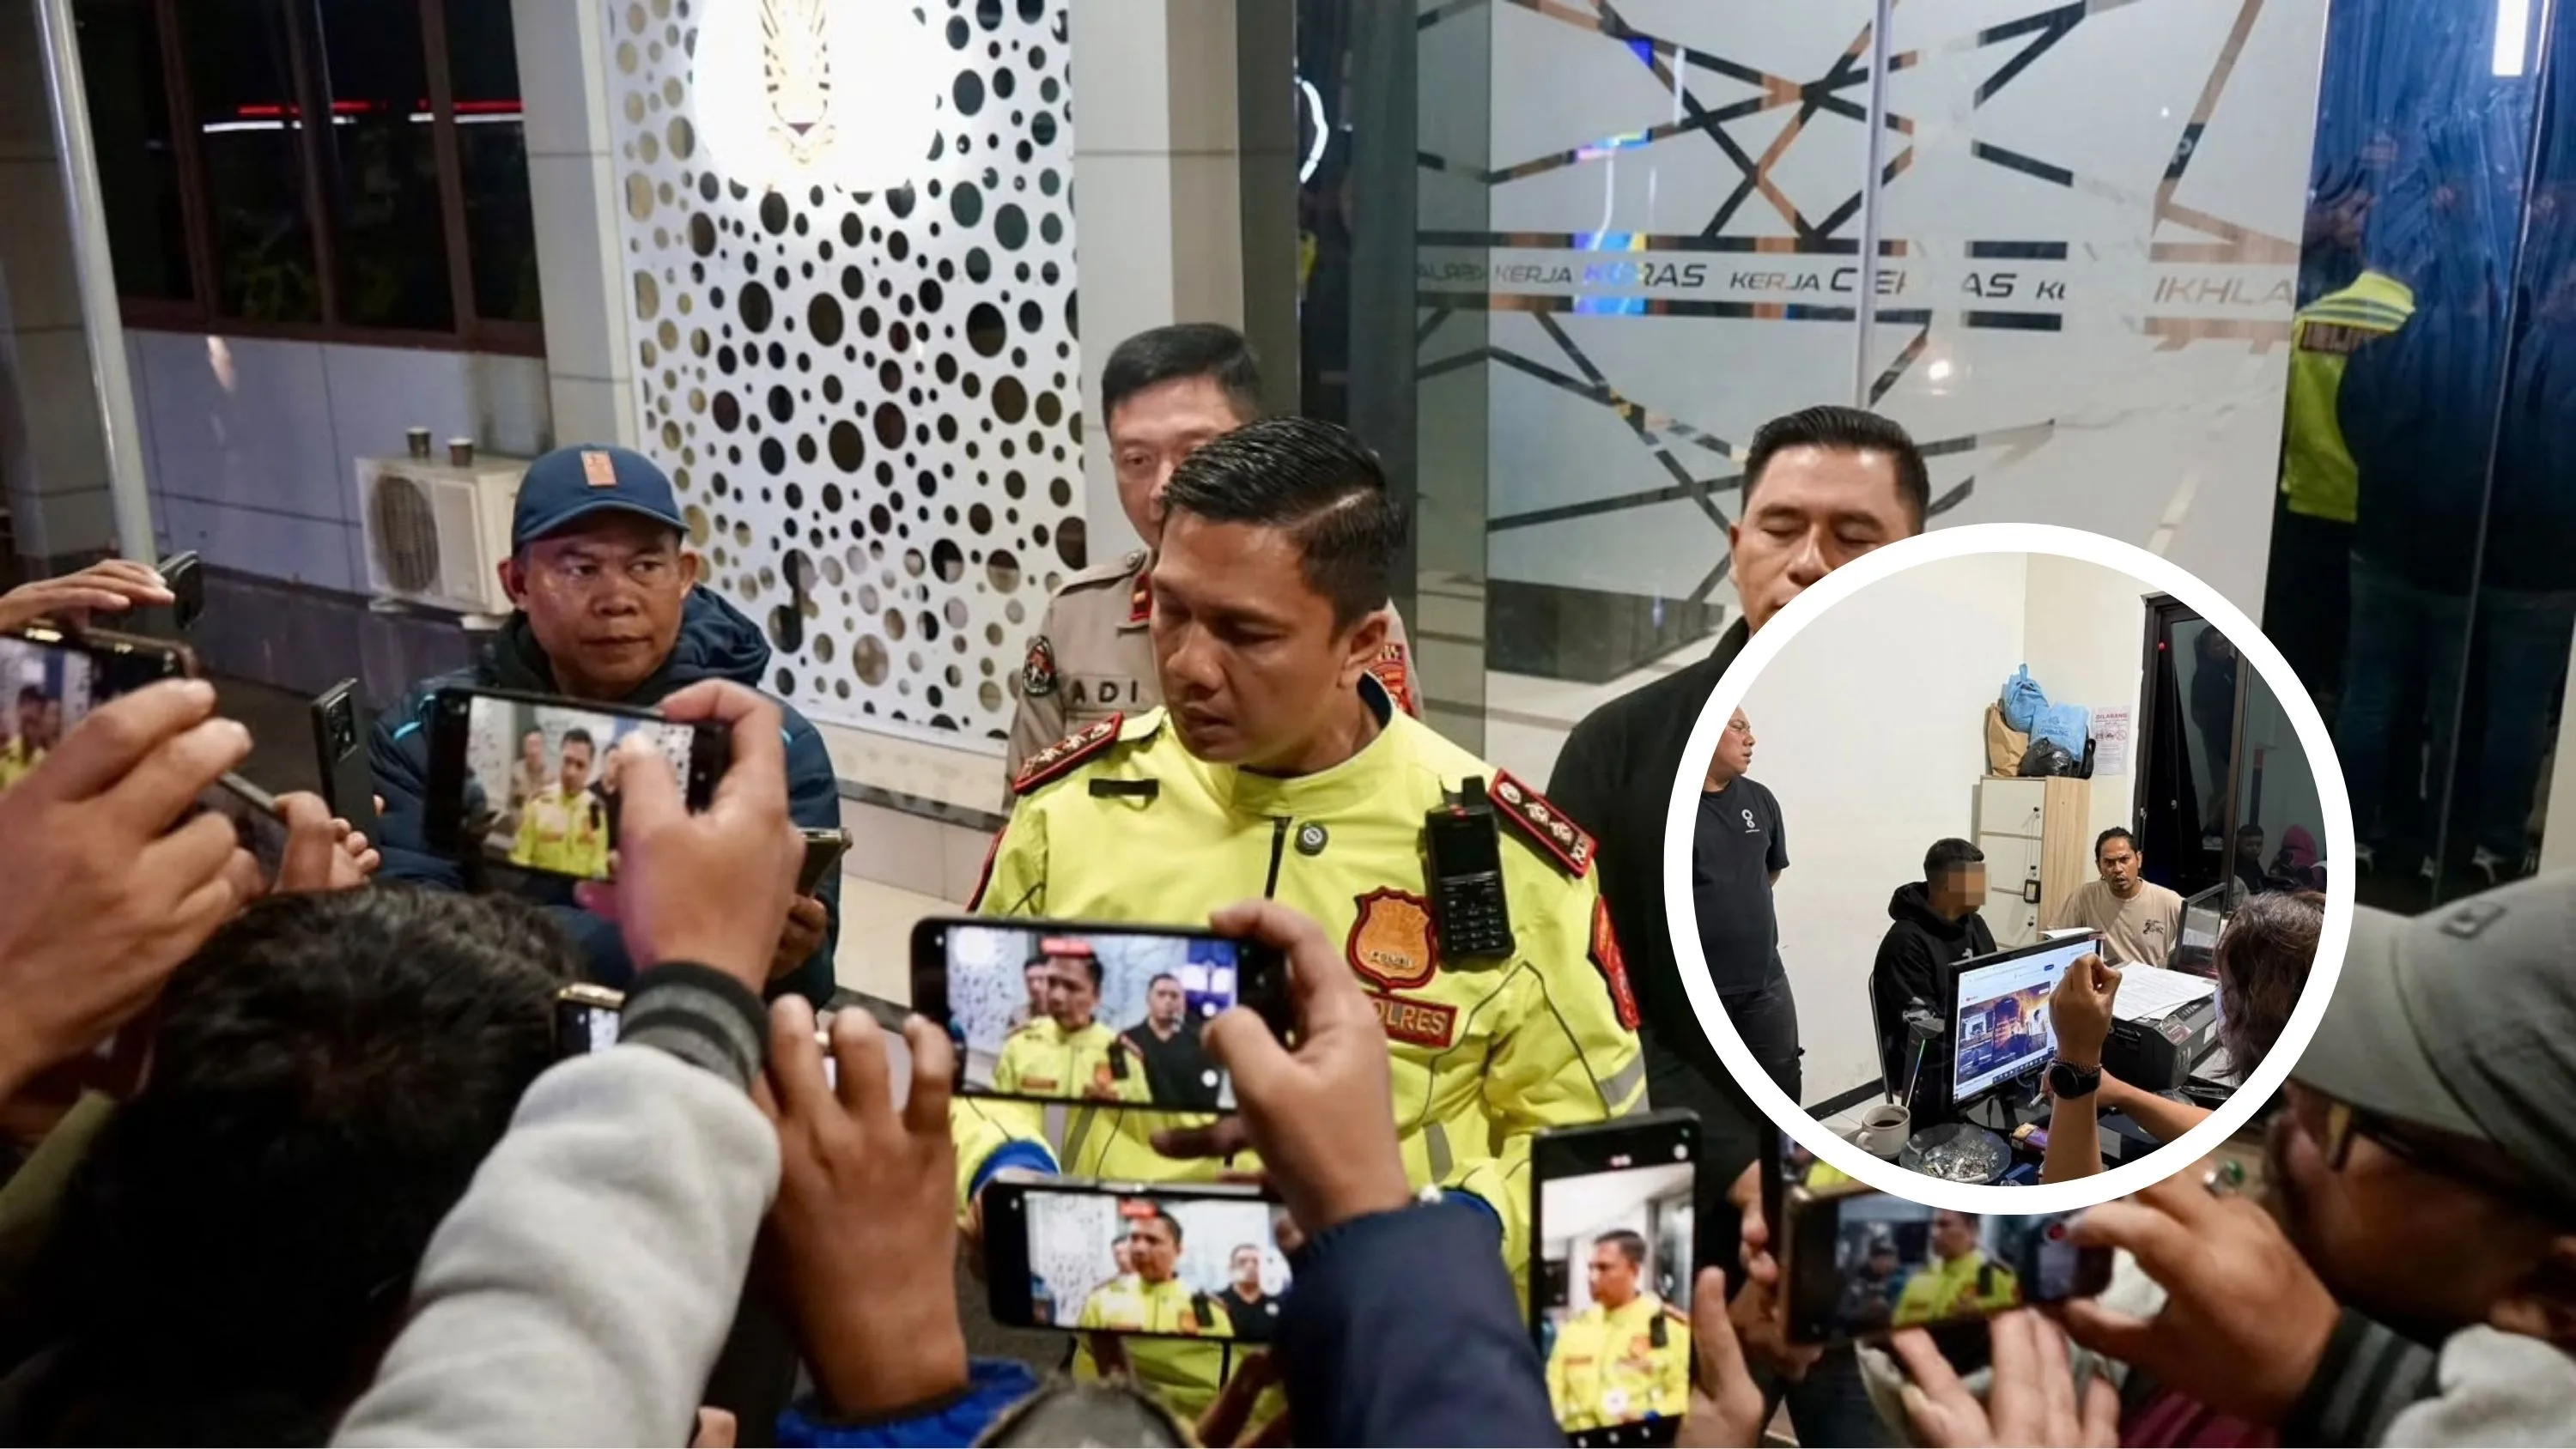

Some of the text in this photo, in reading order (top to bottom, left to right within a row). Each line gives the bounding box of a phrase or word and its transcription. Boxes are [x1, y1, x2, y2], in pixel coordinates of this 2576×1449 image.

[1495, 264, 1572, 284] KERJA
[1729, 270, 1820, 291] KERJA
[1831, 267, 2017, 298] CEAS
[2153, 275, 2293, 305] IKHLA
[1070, 679, 1139, 703] ADI
